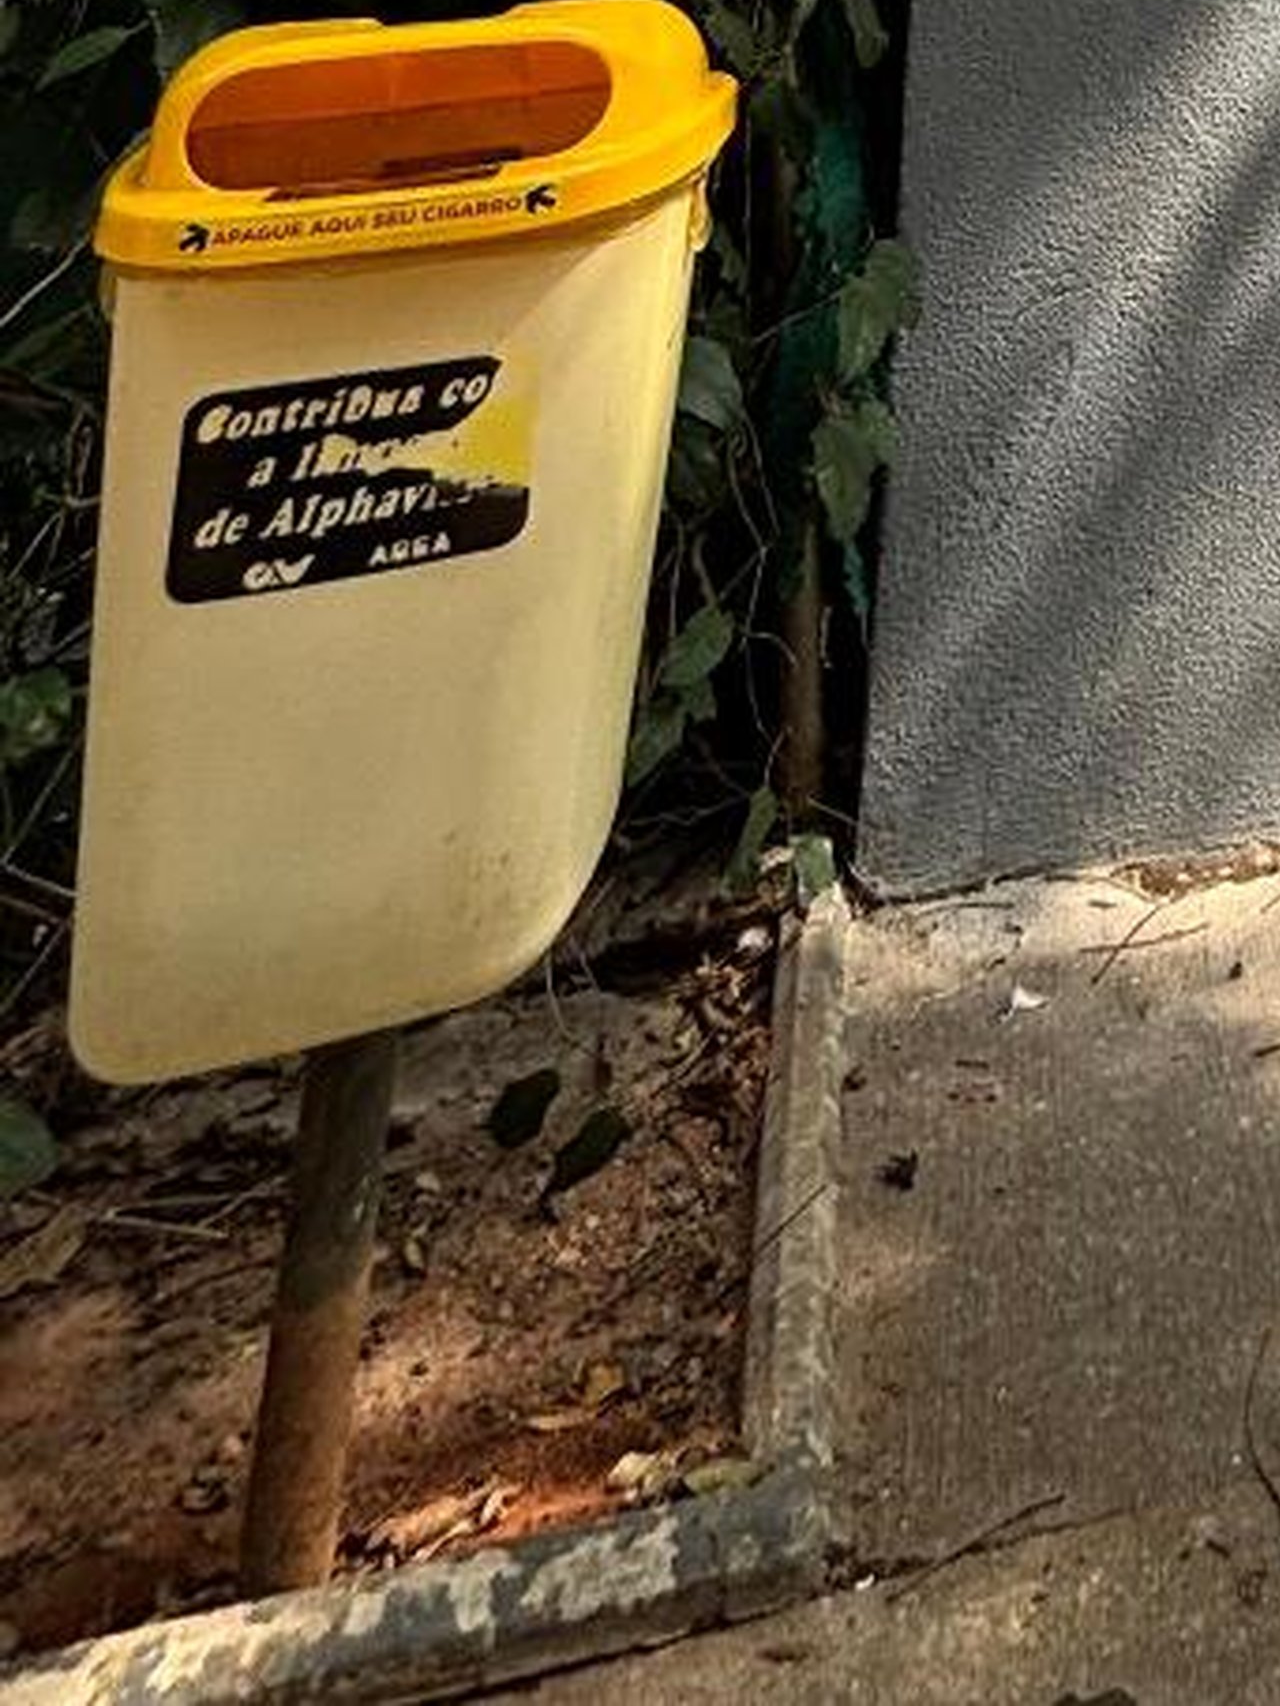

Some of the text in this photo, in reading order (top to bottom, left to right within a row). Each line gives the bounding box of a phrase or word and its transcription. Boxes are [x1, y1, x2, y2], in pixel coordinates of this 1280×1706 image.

[309, 218, 367, 238] AQUI
[420, 196, 522, 224] CIGARRO
[194, 509, 249, 549] de
